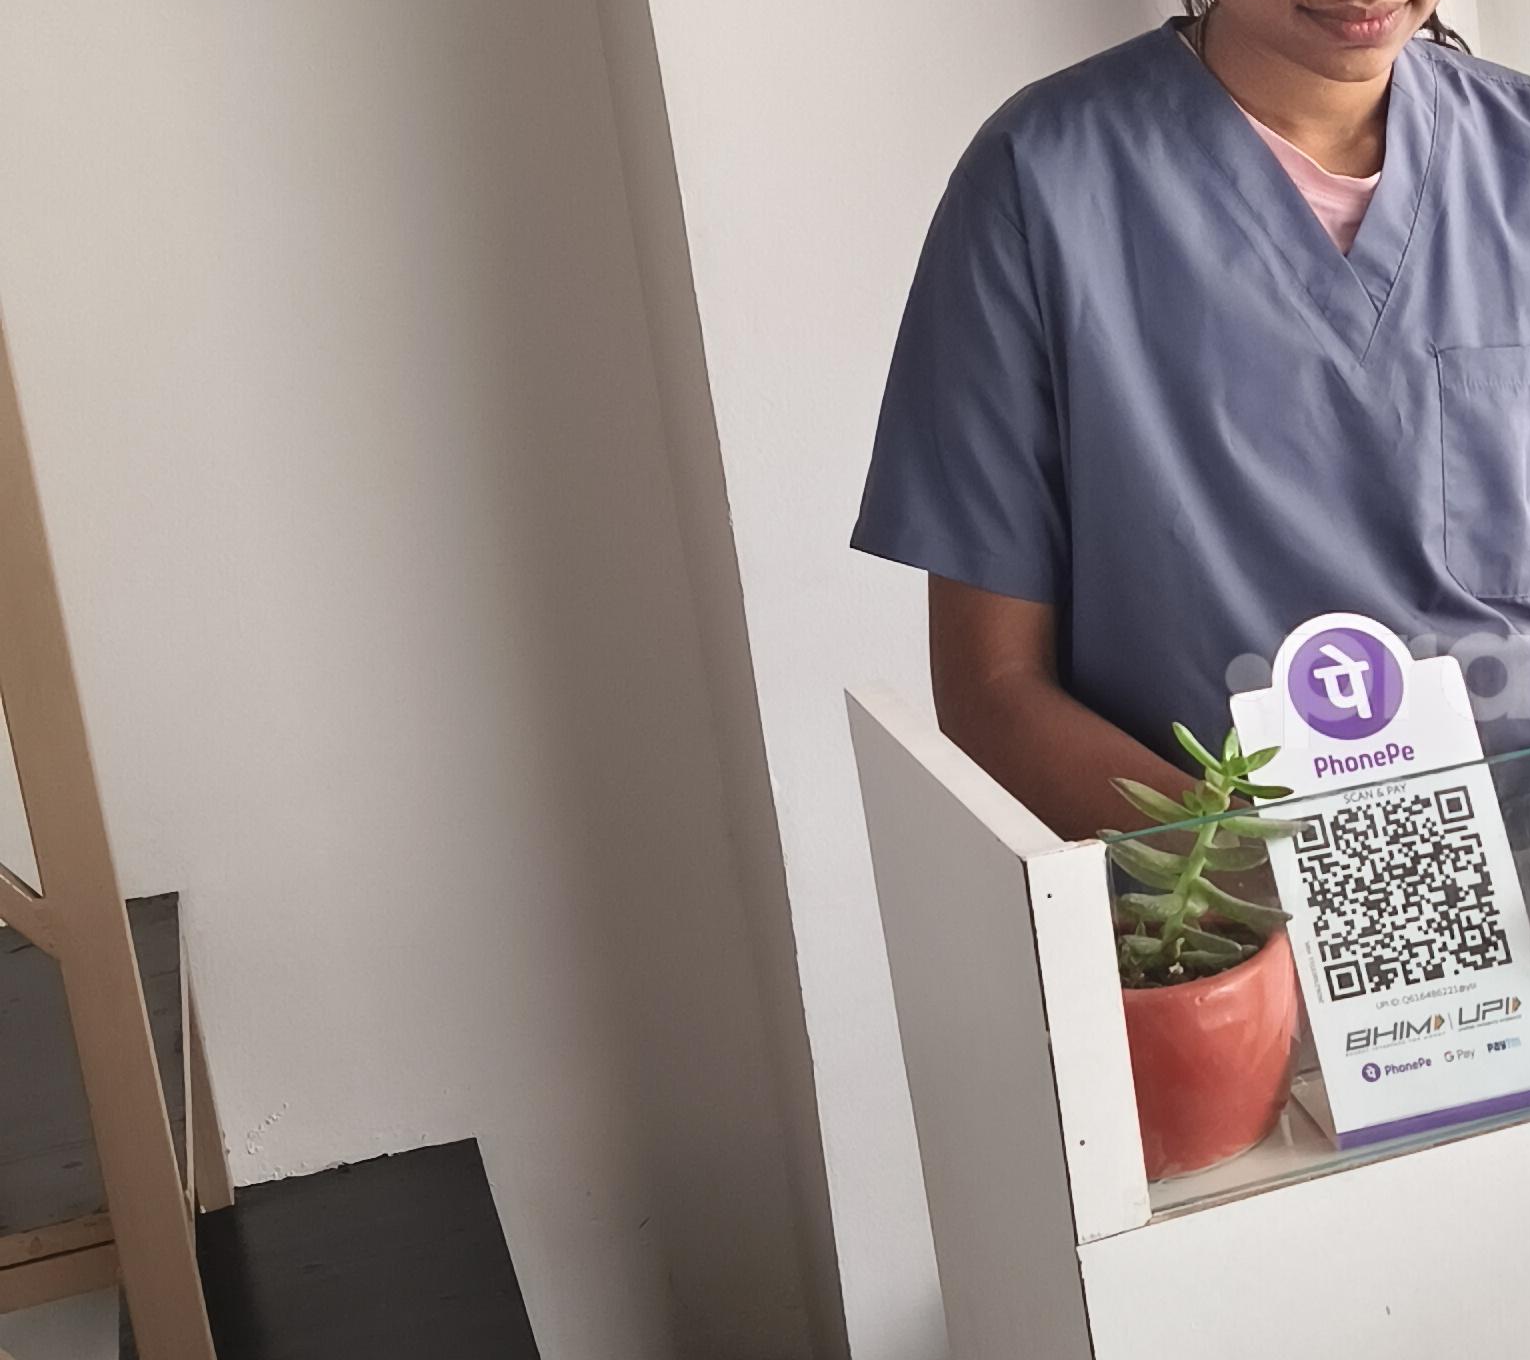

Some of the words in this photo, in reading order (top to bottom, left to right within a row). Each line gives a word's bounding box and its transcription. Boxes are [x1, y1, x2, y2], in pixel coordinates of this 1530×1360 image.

[1313, 742, 1415, 778] PhonePe
[1343, 789, 1374, 805] SCAN
[1386, 783, 1407, 796] PAY
[1345, 1014, 1433, 1052] BHIM
[1458, 996, 1511, 1026] UPI
[1384, 1057, 1433, 1077] PhonePe
